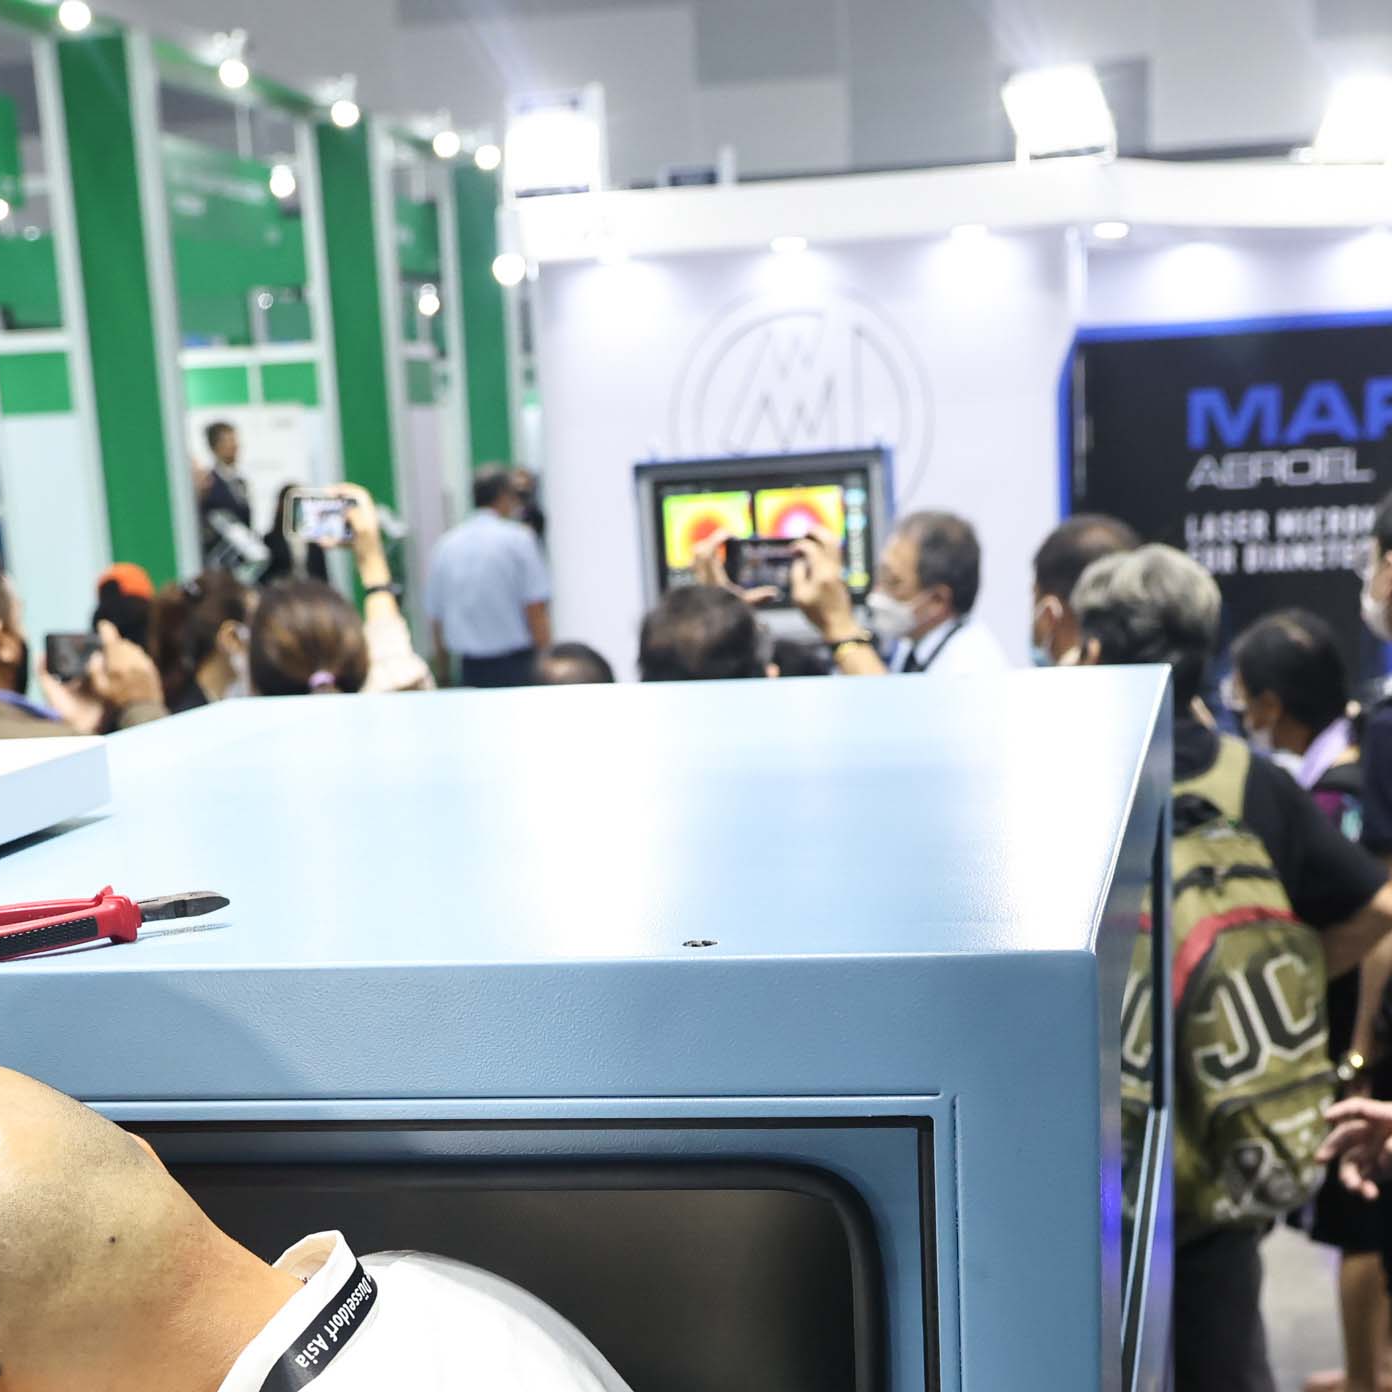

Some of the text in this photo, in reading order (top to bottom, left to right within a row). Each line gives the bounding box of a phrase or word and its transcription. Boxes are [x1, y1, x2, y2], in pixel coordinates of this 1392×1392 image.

[1186, 446, 1376, 491] AEROEL
[1184, 508, 1270, 544] LASER
[294, 1276, 374, 1369] Düsseldorf Asia
